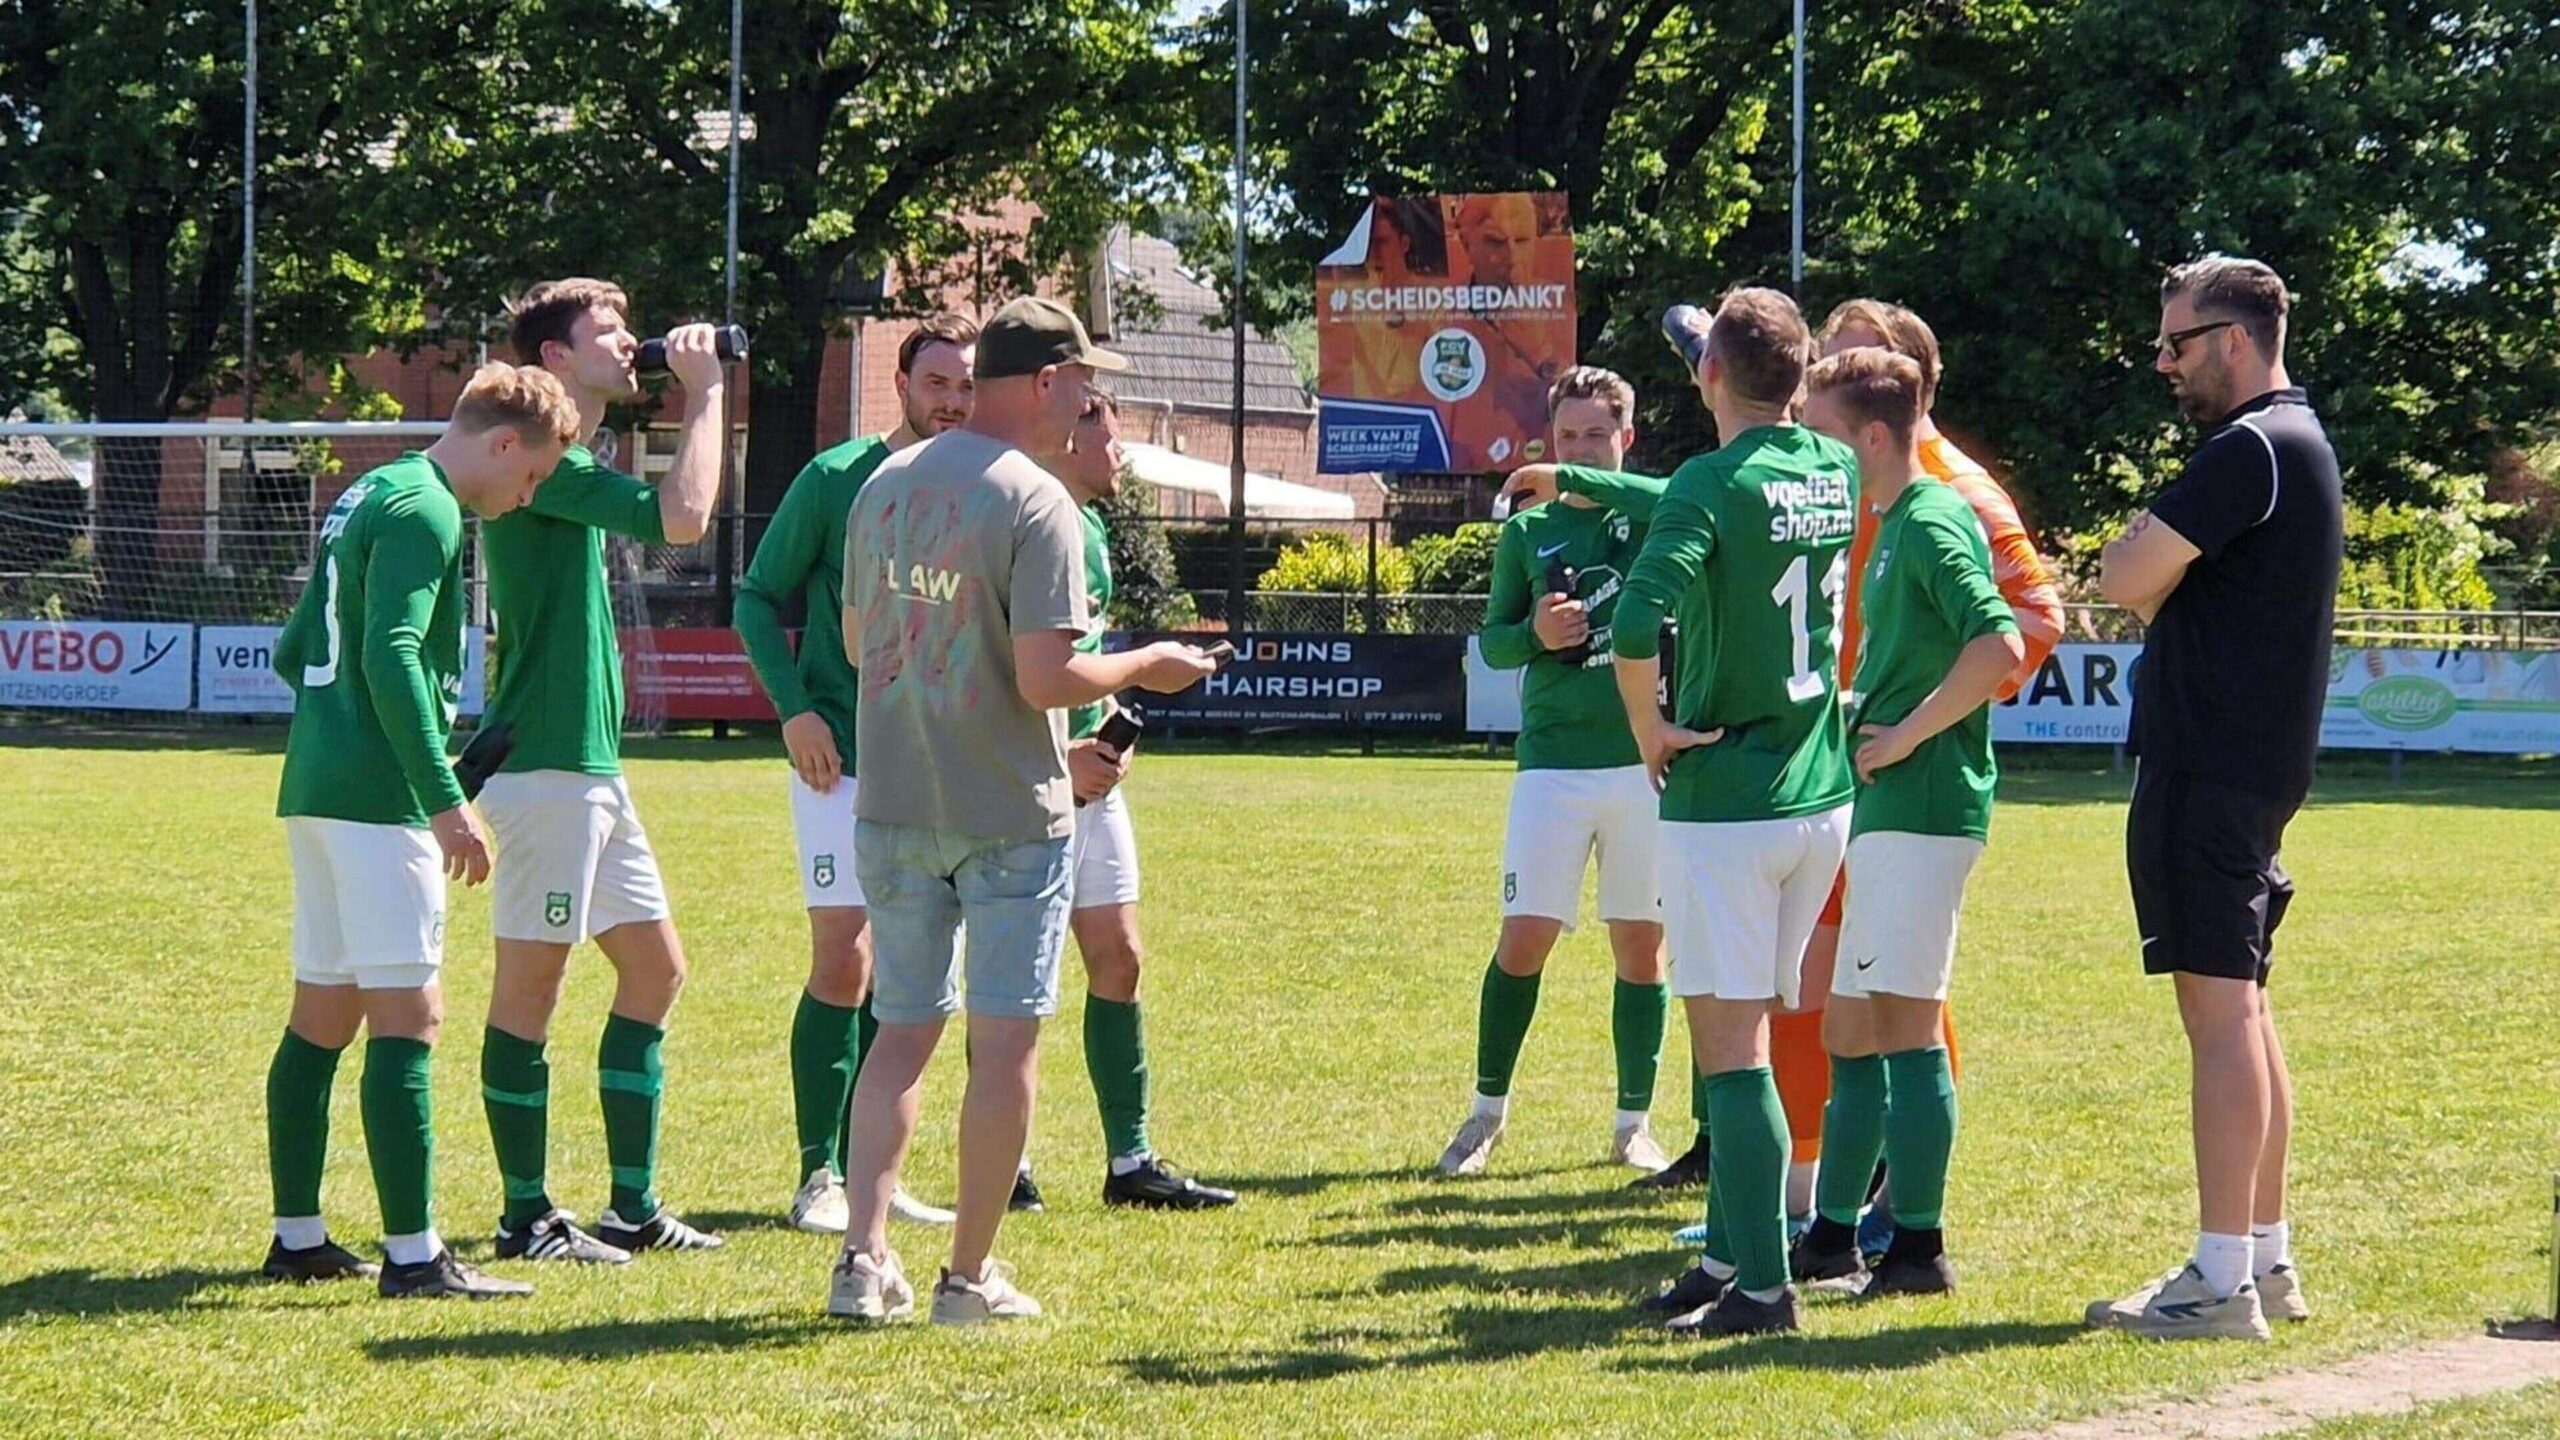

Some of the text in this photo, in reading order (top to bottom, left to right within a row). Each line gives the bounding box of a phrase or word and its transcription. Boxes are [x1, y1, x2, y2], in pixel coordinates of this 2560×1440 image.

[1330, 284, 1567, 313] #SCHEIDSBEDANKT
[1328, 430, 1420, 442] WEEK VAN DE
[888, 559, 961, 601] LAW
[1771, 548, 1848, 702] 11
[0, 630, 124, 674] VEBO
[216, 646, 270, 668] ven
[1233, 638, 1351, 662] JOHNS
[1205, 673, 1382, 697] HAIRSHOP
[2025, 722, 2126, 738] THE control
